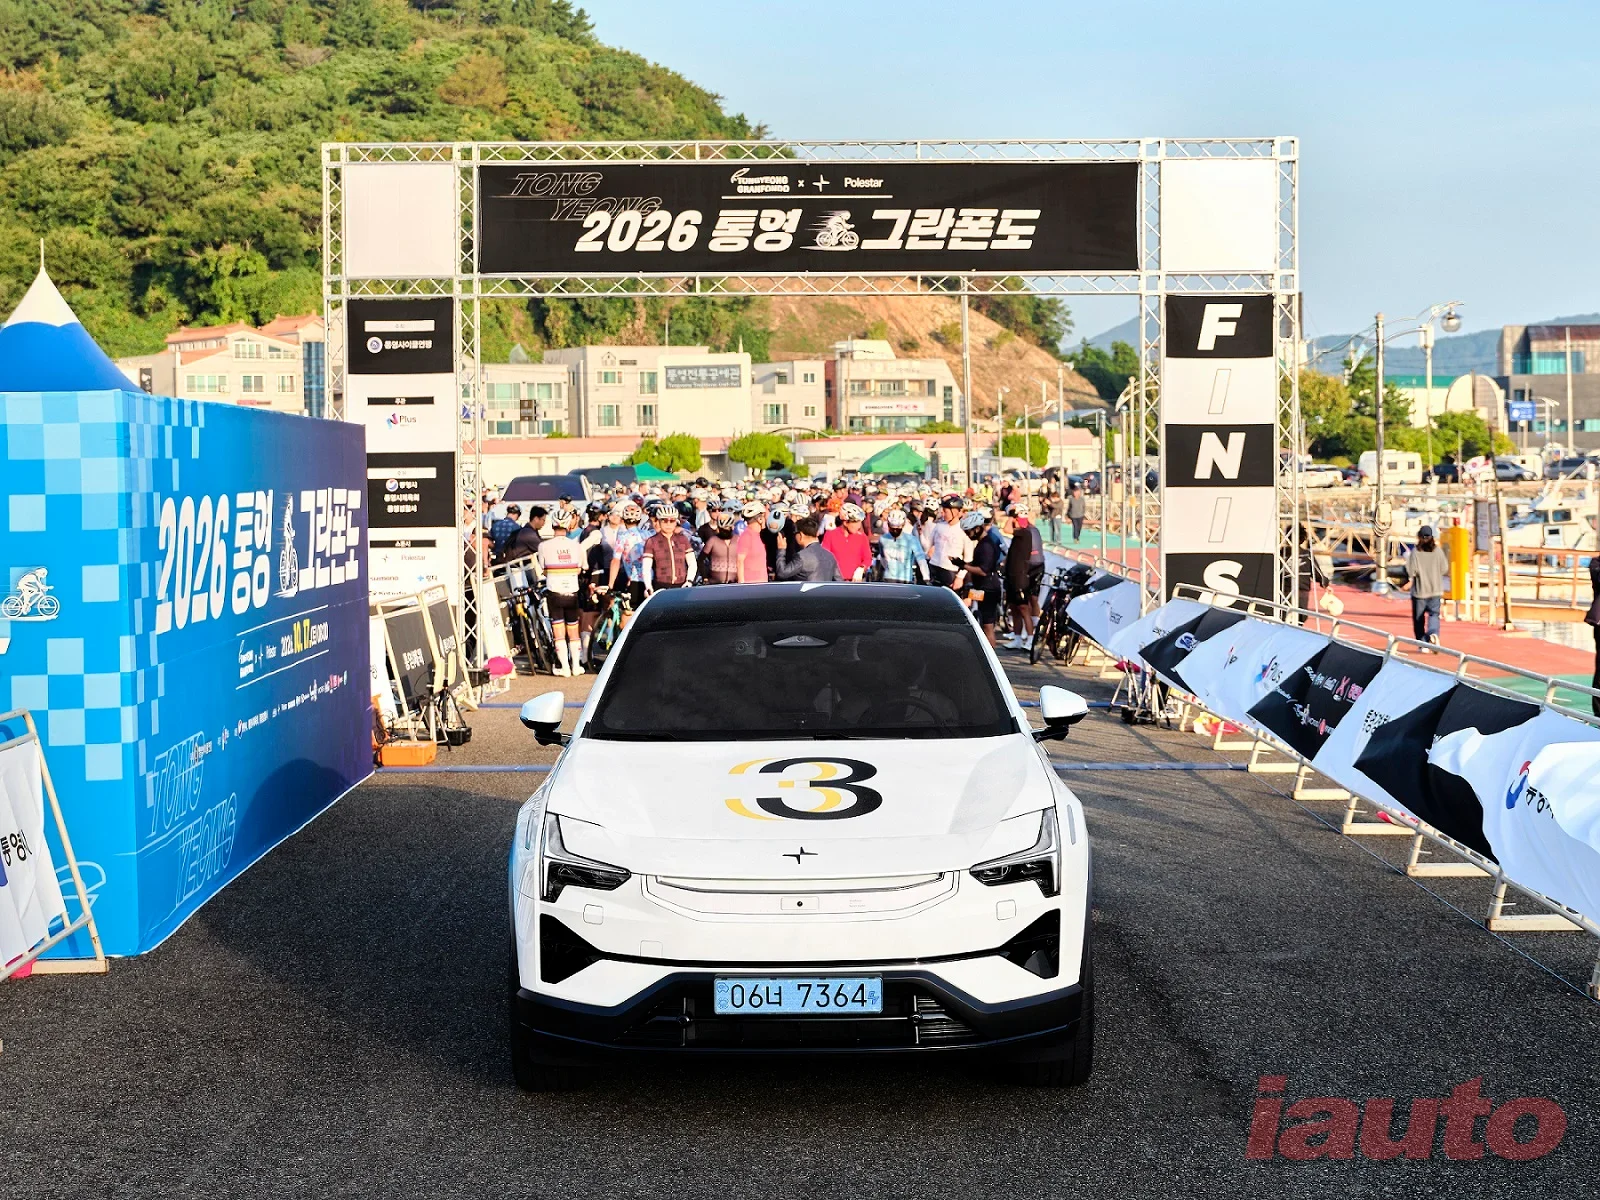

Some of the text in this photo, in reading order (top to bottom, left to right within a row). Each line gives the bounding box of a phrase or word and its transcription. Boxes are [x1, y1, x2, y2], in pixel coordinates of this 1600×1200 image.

[511, 172, 603, 196] TONG
[737, 185, 790, 194] GRANFONDO
[844, 177, 884, 189] Polestar
[550, 197, 663, 221] YEONG
[574, 208, 1042, 252] 2026 통영 그란폰도
[666, 368, 740, 382] 통영전통공예관
[155, 487, 361, 635] 2026 통영 그란폰도
[725, 757, 883, 821] 3
[797, 984, 867, 1007] 7364
